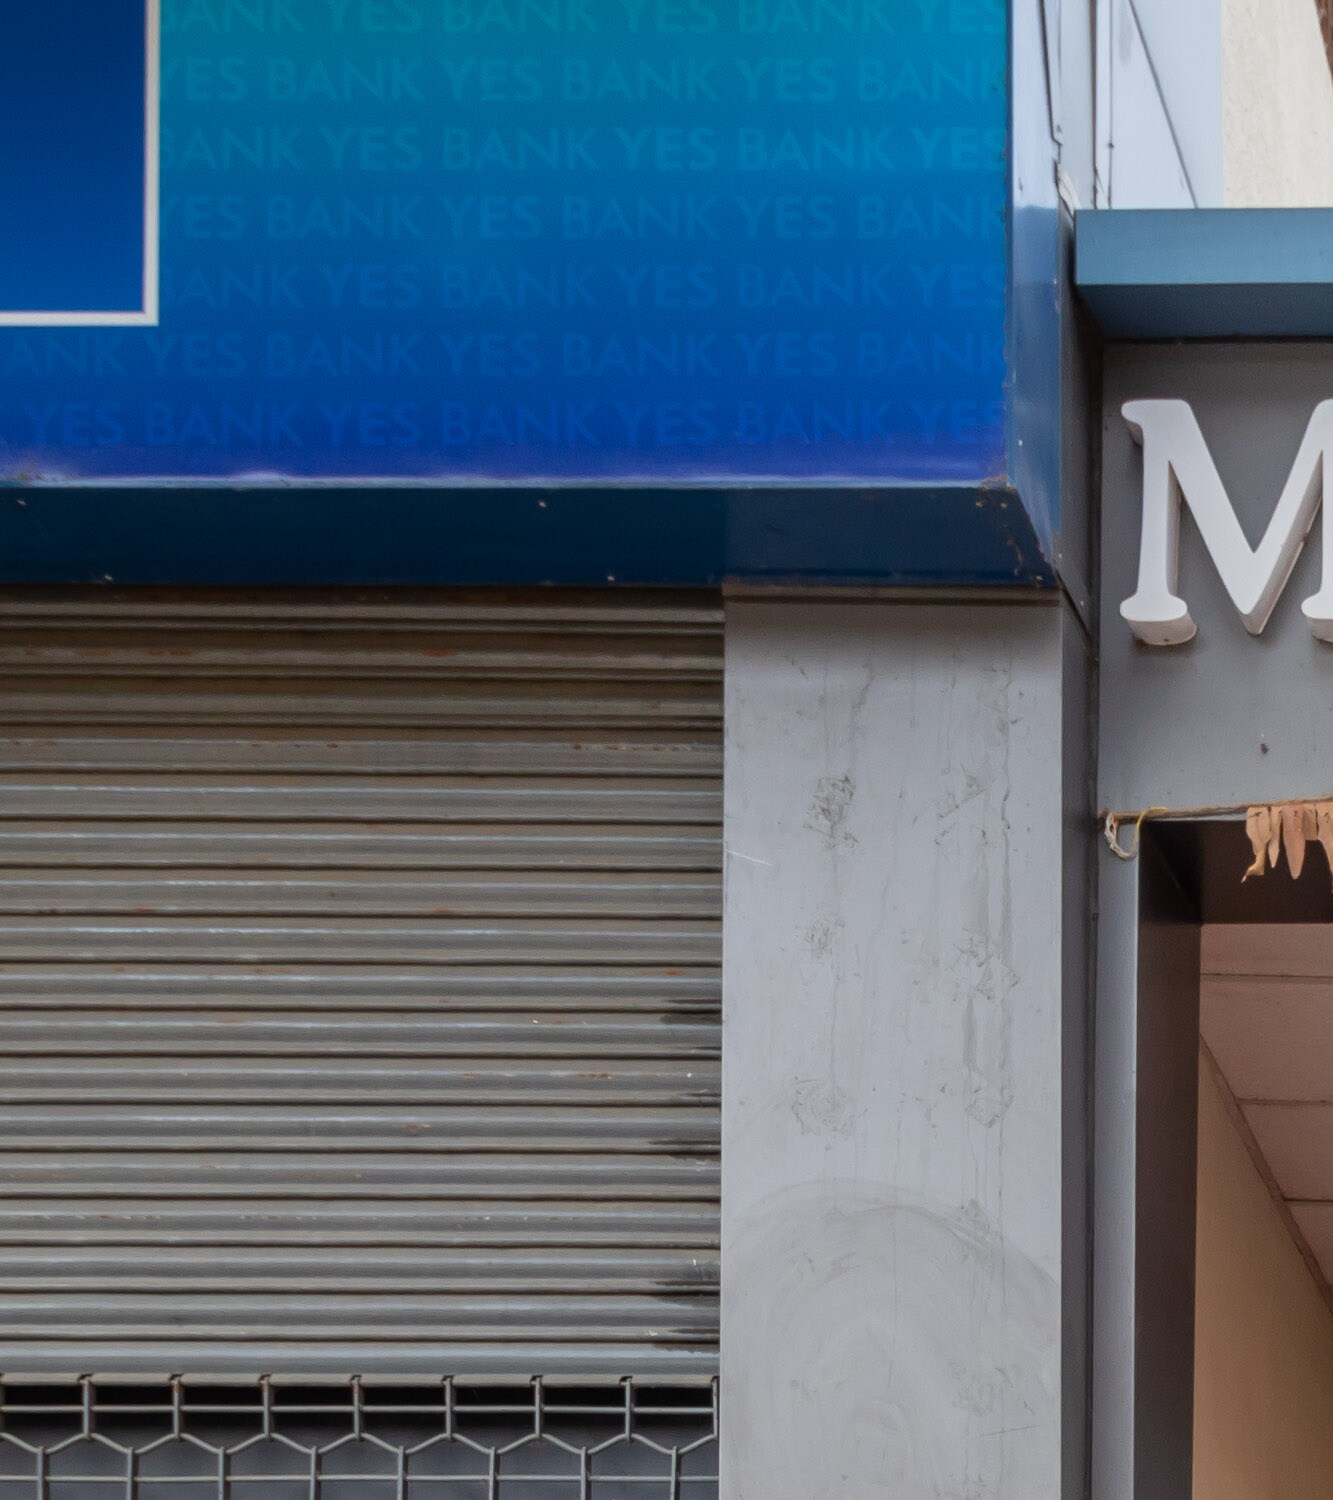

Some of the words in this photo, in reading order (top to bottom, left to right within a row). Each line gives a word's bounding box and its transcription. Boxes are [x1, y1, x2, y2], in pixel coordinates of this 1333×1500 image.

[327, 0, 422, 33] YES
[443, 0, 599, 33] BANK
[622, 0, 718, 33] YES
[737, 0, 894, 33] BANK
[267, 57, 425, 102] BANK
[440, 57, 543, 102] YES
[562, 57, 719, 102] BANK
[735, 57, 838, 102] YES
[320, 127, 423, 171] YES
[442, 127, 599, 171] BANK
[615, 127, 718, 171] YES
[738, 127, 895, 171] BANK
[267, 195, 424, 240] BANK
[440, 195, 542, 240] YES
[562, 195, 719, 240] BANK
[735, 195, 838, 240] YES
[316, 264, 422, 308] YES
[440, 264, 598, 308] BANK
[614, 264, 717, 308] YES
[736, 264, 895, 308] BANK
[147, 333, 246, 377] YES
[266, 333, 424, 377] BANK
[439, 333, 542, 377] YES
[561, 333, 719, 377] BANK
[735, 333, 838, 377] YES
[20, 402, 126, 446] YES
[145, 402, 303, 446] BANK
[318, 402, 422, 446] YES
[441, 402, 598, 446] BANK
[612, 402, 717, 446] YES
[736, 402, 893, 446] BANK
